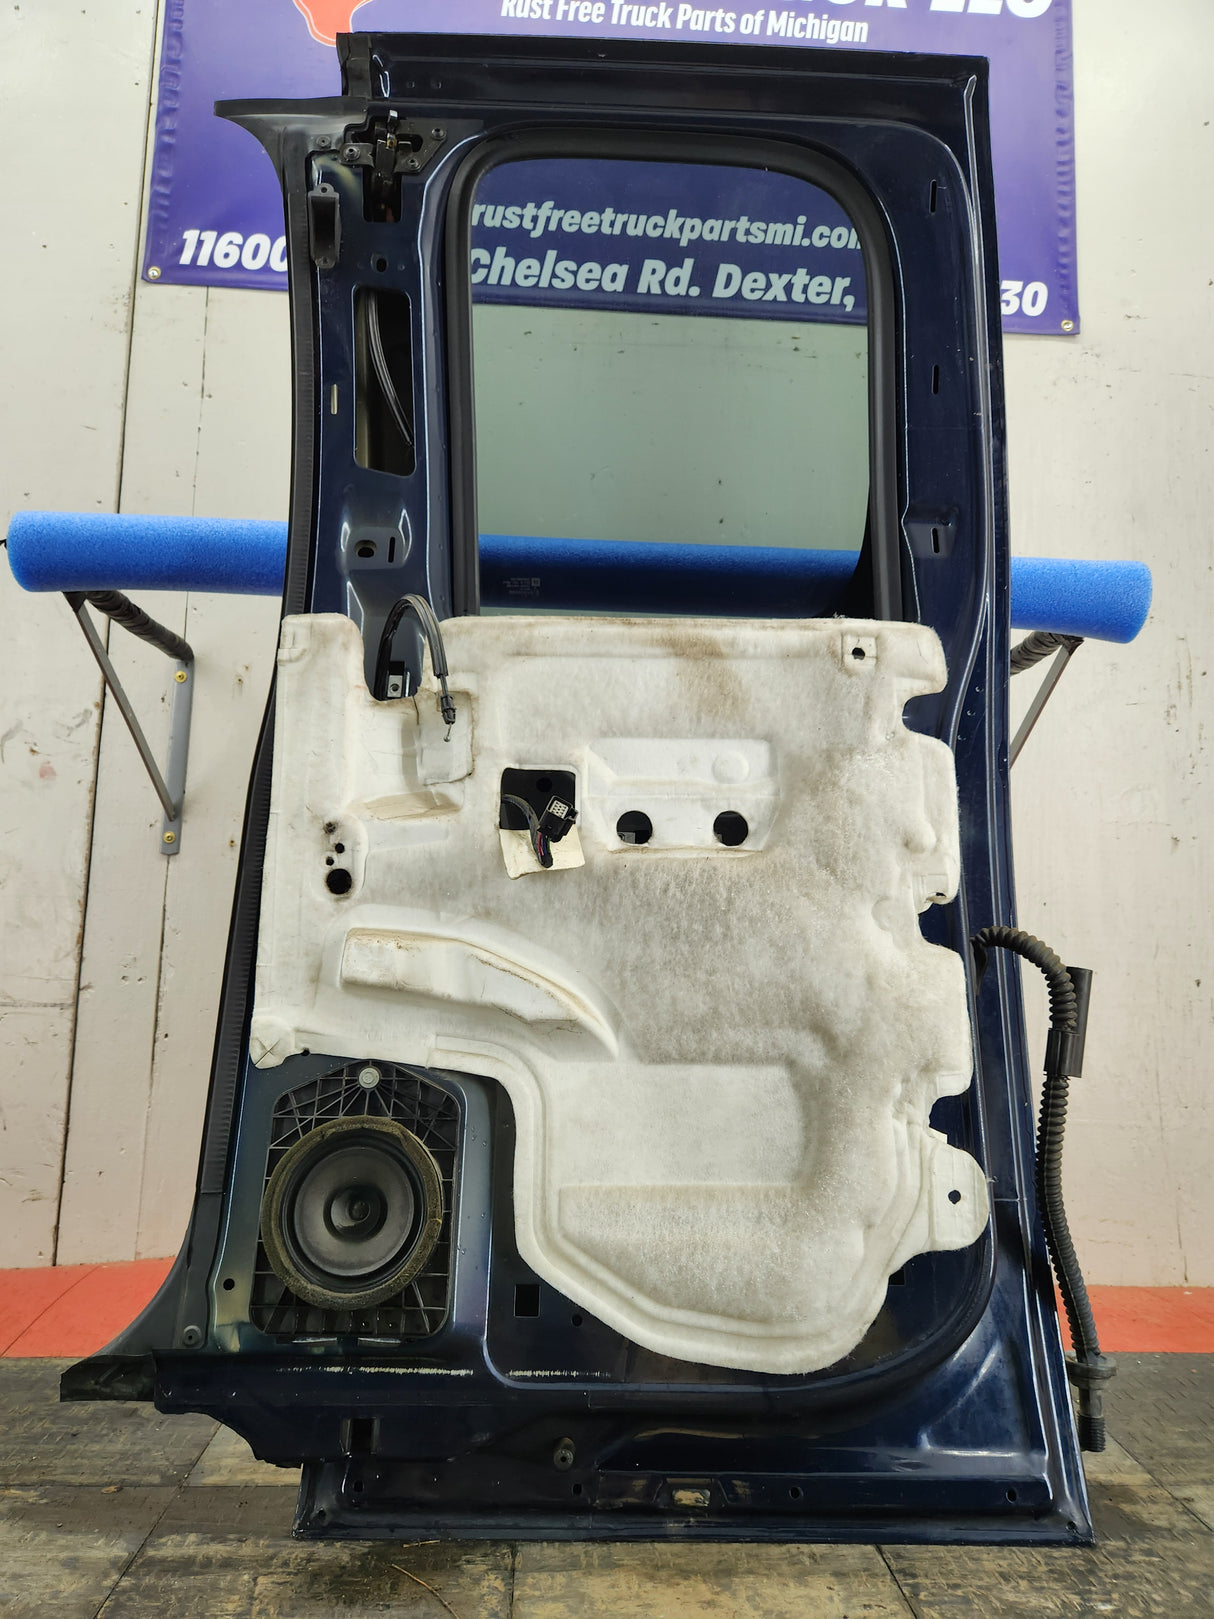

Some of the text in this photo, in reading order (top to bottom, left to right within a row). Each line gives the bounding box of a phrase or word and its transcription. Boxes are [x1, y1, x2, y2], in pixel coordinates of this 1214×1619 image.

[501, 0, 869, 44] Rust Free Truck Parts of Michigan
[471, 246, 629, 293] Chelsea
[636, 258, 700, 297] Rd.
[712, 263, 856, 312] Dexter,
